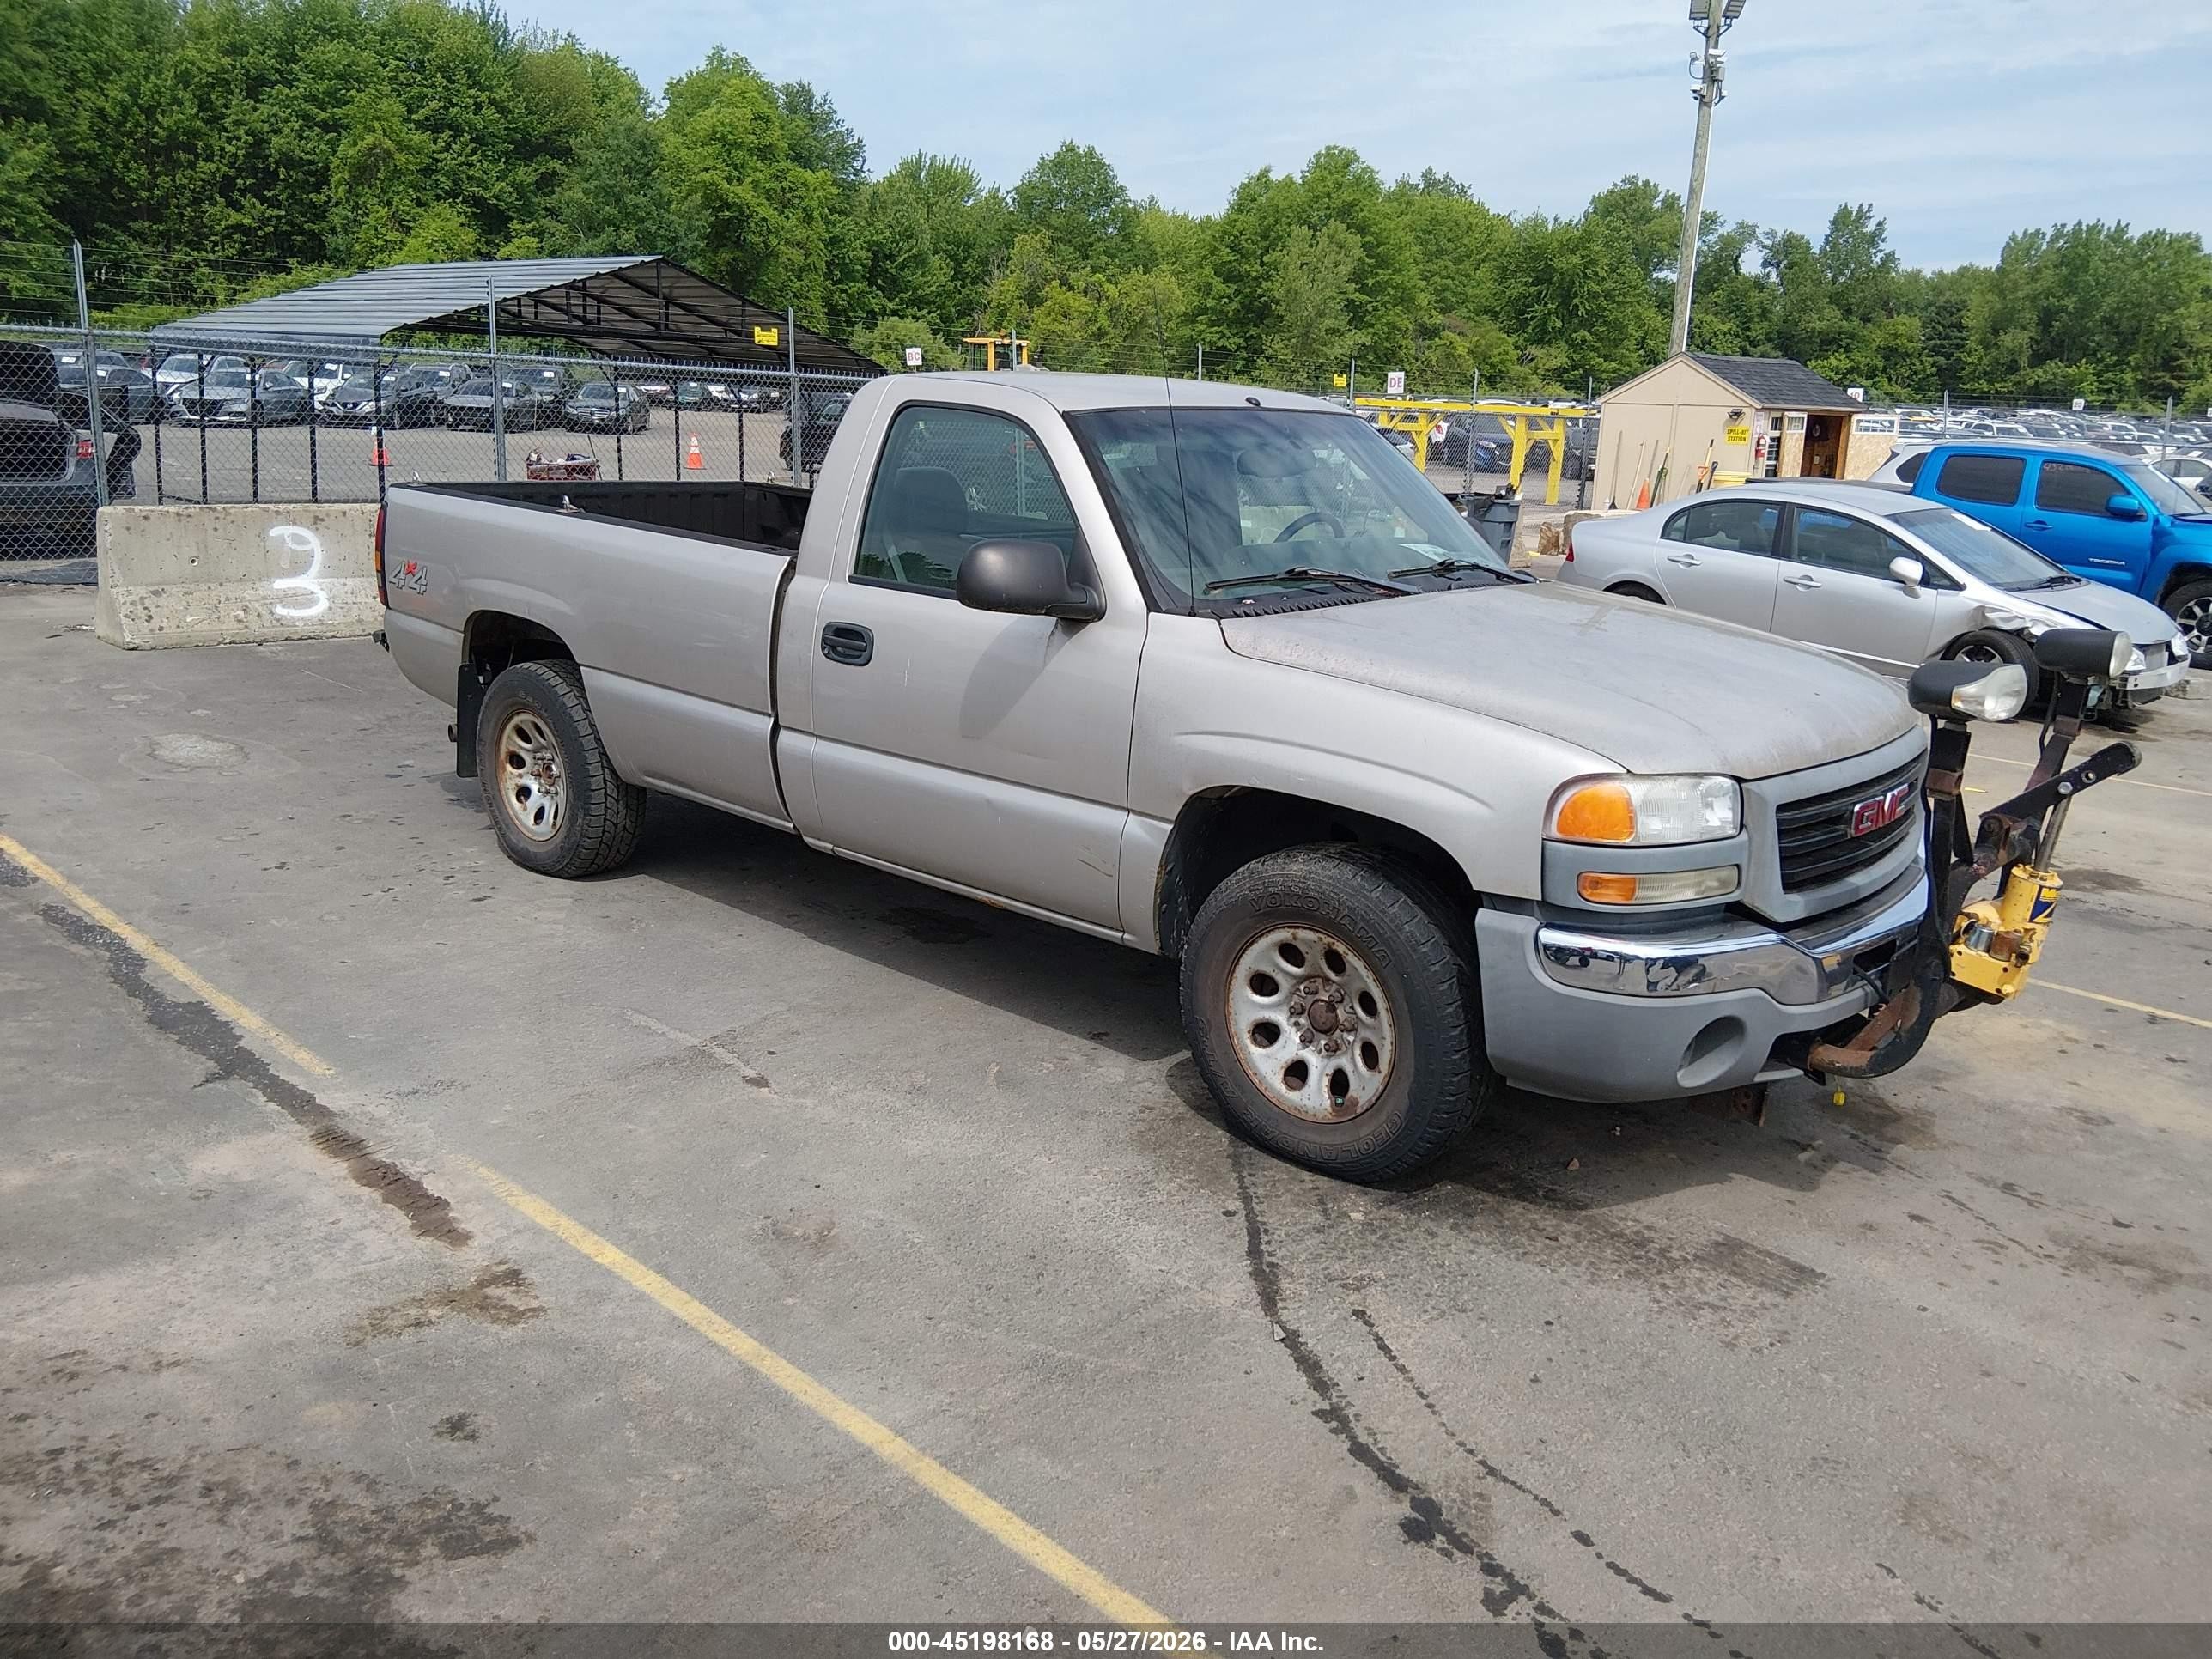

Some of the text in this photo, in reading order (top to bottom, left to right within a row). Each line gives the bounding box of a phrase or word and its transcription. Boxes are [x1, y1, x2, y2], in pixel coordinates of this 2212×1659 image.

[908, 352, 921, 362] BC
[1389, 377, 1403, 388] DE
[269, 526, 330, 617] 3
[1851, 783, 1910, 837] GMC
[1249, 892, 1392, 969] YOKOHAMA
[1243, 1106, 1402, 1160] GEOLANDAR
